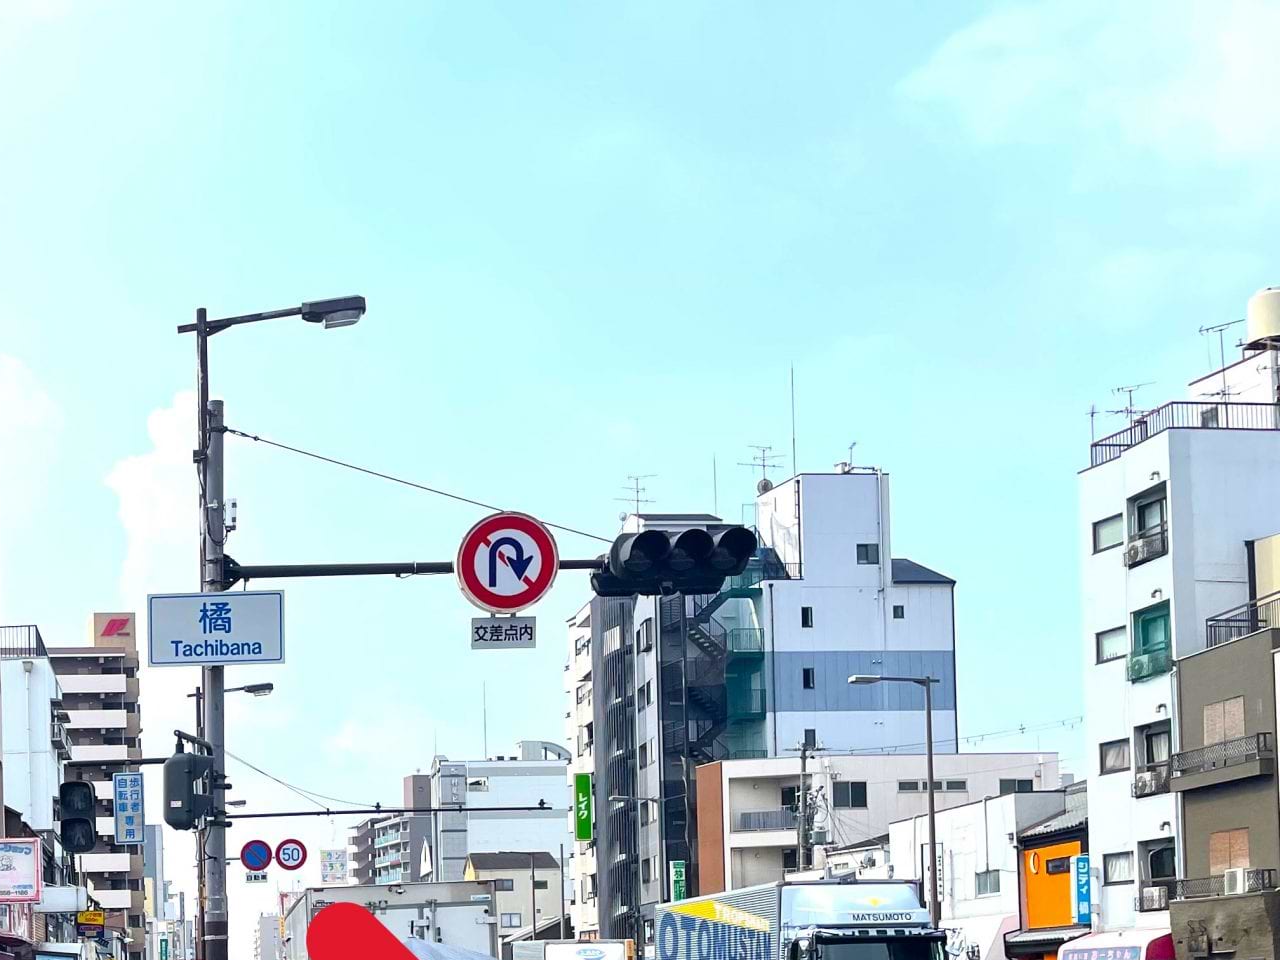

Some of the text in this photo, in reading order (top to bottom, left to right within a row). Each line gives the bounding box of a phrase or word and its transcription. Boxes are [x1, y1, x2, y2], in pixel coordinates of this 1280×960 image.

[199, 602, 232, 634] 橘
[474, 624, 533, 642] 交差点内
[170, 640, 262, 656] Tachibana
[118, 778, 128, 812] 自転車
[129, 777, 140, 812] 歩行者
[578, 793, 588, 820] レイク
[282, 848, 300, 861] 50
[852, 913, 912, 923] MATSUMOTO
